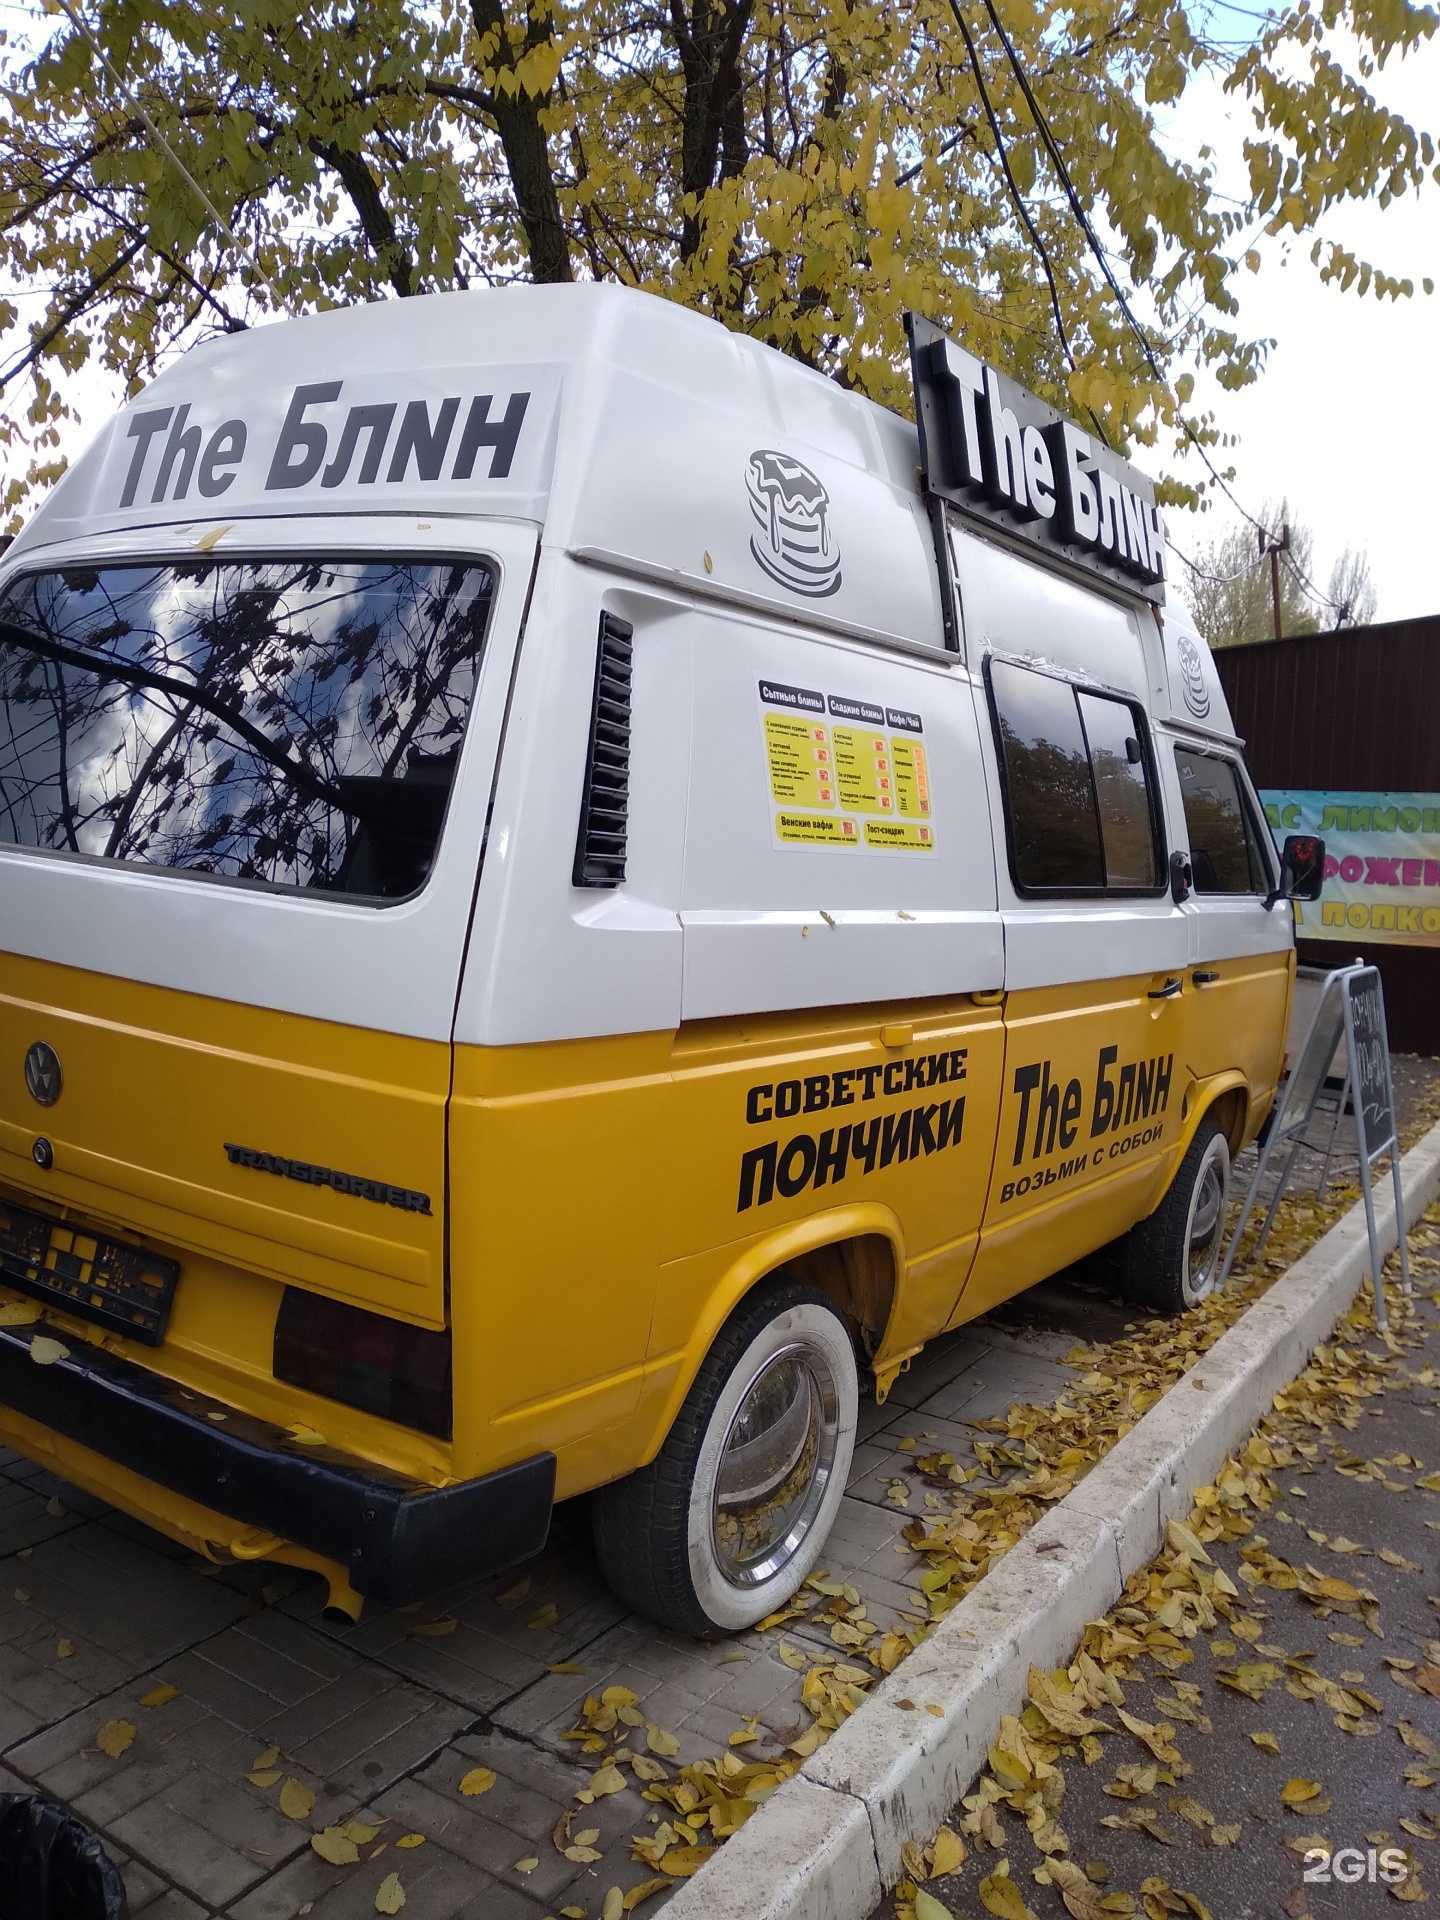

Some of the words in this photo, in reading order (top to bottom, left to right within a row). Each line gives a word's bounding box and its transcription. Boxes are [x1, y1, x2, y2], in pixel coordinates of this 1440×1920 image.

[118, 403, 248, 508] The
[930, 337, 1056, 519] The
[762, 687, 796, 702] Сытные
[797, 693, 823, 709] блины
[830, 700, 860, 716] Сладкие
[860, 708, 883, 720] блины
[781, 816, 811, 828] Венские
[812, 820, 834, 830] вафли
[746, 1048, 968, 1125] СОВЕТСКИЕ
[1012, 1060, 1082, 1166] The
[224, 1143, 433, 1216] TRANSPORTER
[736, 1096, 966, 1213] ПОНЧИКИ
[1000, 1154, 1088, 1204] ВОЗЬМИ
[1092, 1147, 1105, 1166] С
[1109, 1120, 1164, 1159] СОБОЙ
